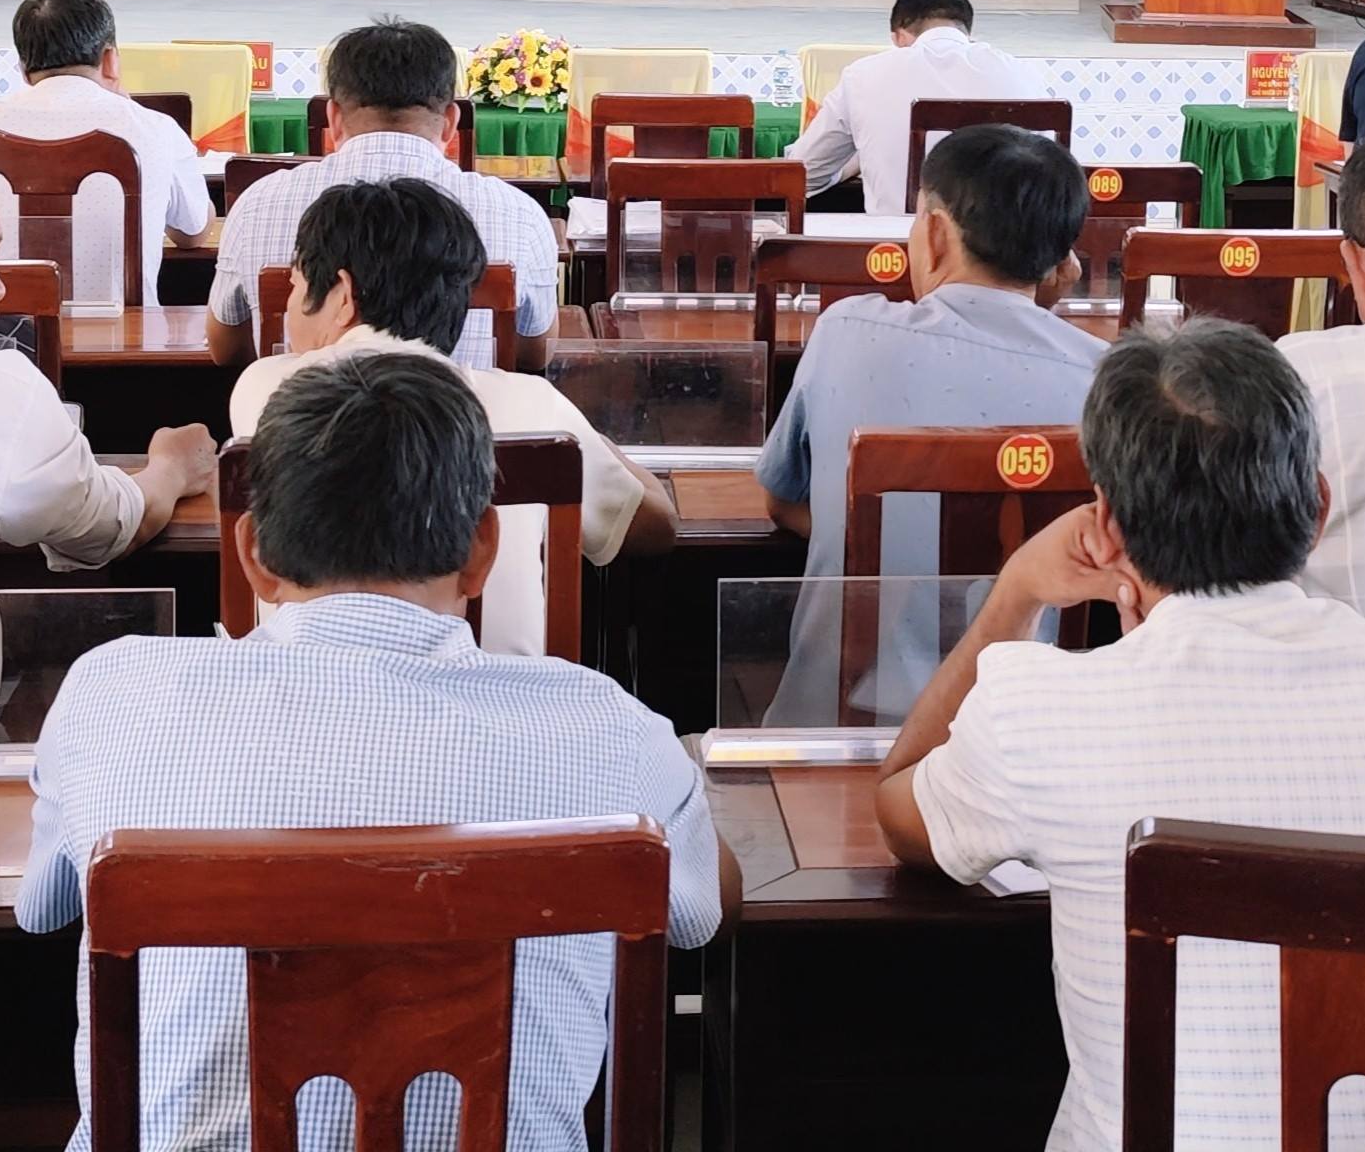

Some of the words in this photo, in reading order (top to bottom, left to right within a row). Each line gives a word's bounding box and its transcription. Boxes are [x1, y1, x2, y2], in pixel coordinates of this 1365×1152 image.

[1091, 175, 1117, 194] 089
[870, 251, 903, 274] 005
[1225, 245, 1254, 269] 095
[1000, 445, 1050, 476] 055
